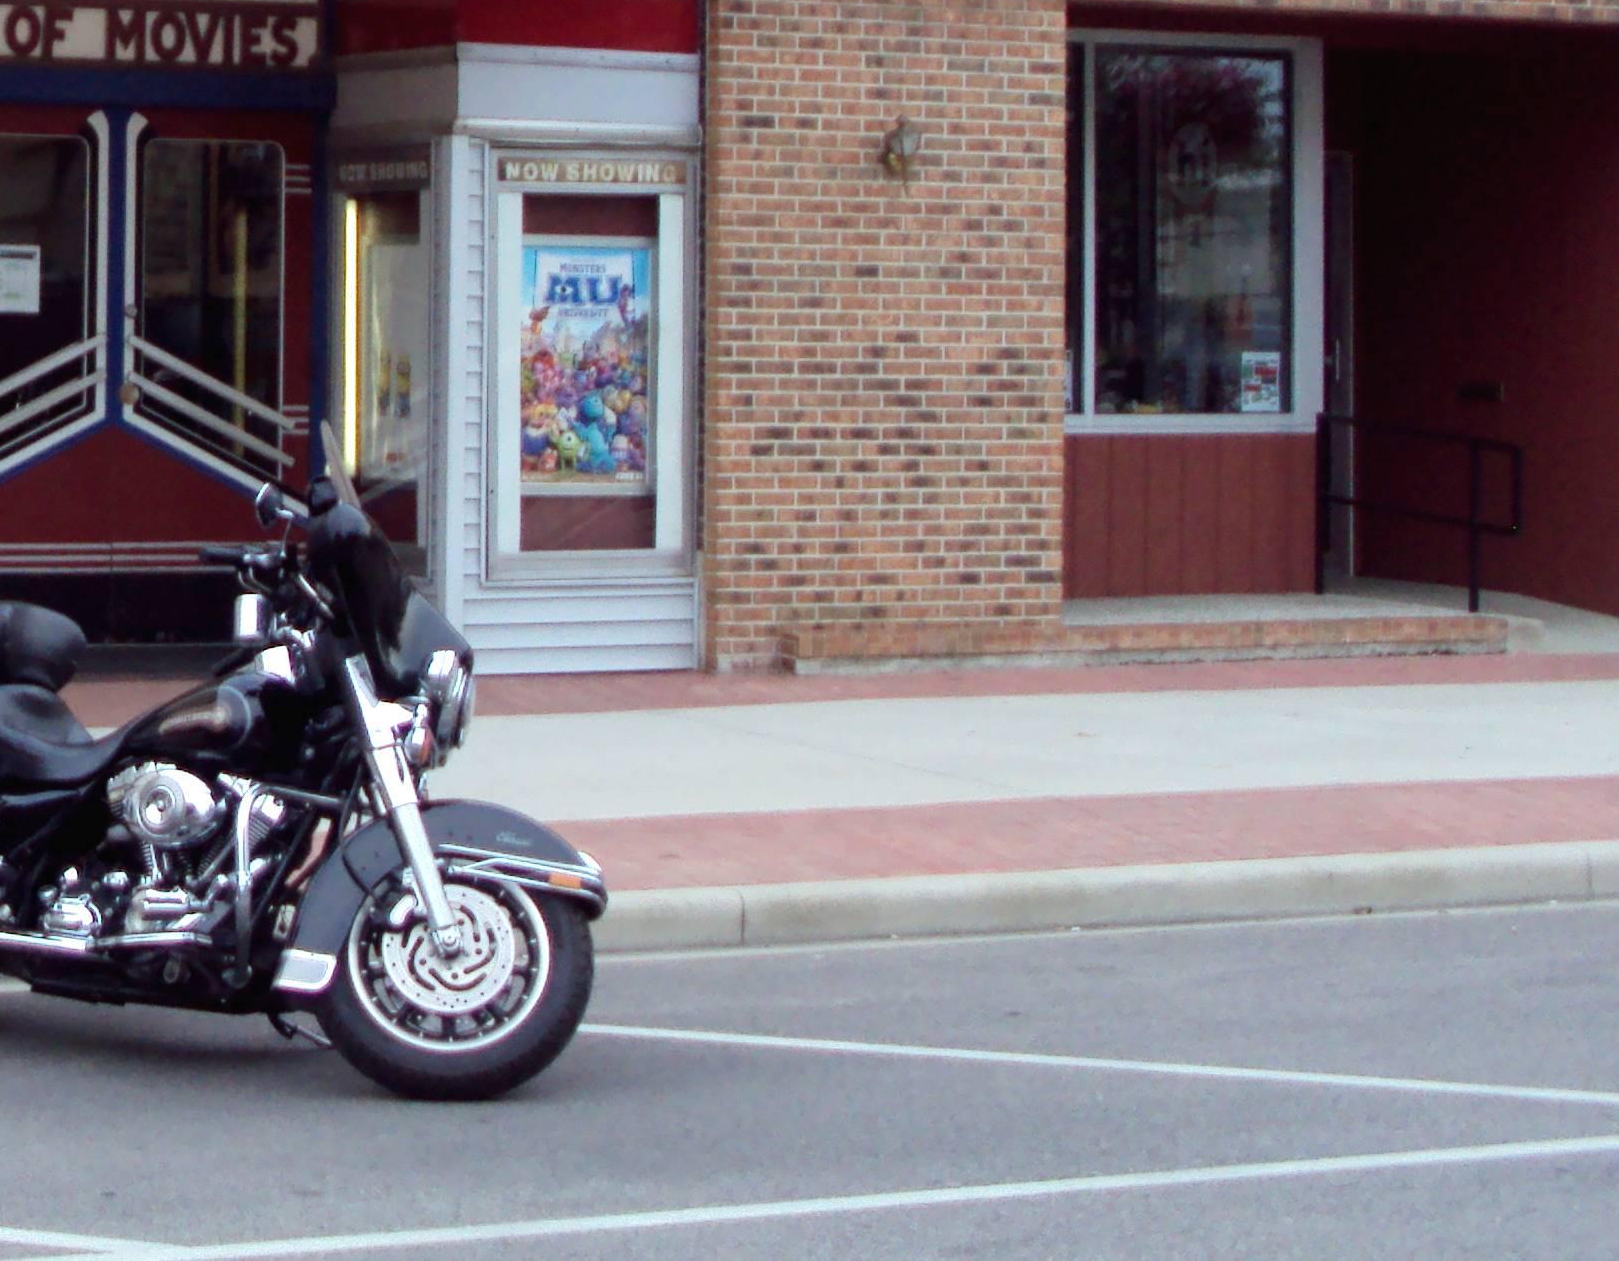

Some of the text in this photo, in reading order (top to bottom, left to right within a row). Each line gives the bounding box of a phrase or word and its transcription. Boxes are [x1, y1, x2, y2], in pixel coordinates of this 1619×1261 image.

[4, 4, 74, 58] OF
[105, 8, 298, 65] MOVIES
[505, 161, 676, 182] NOW SHOWING
[545, 273, 622, 305] MU
